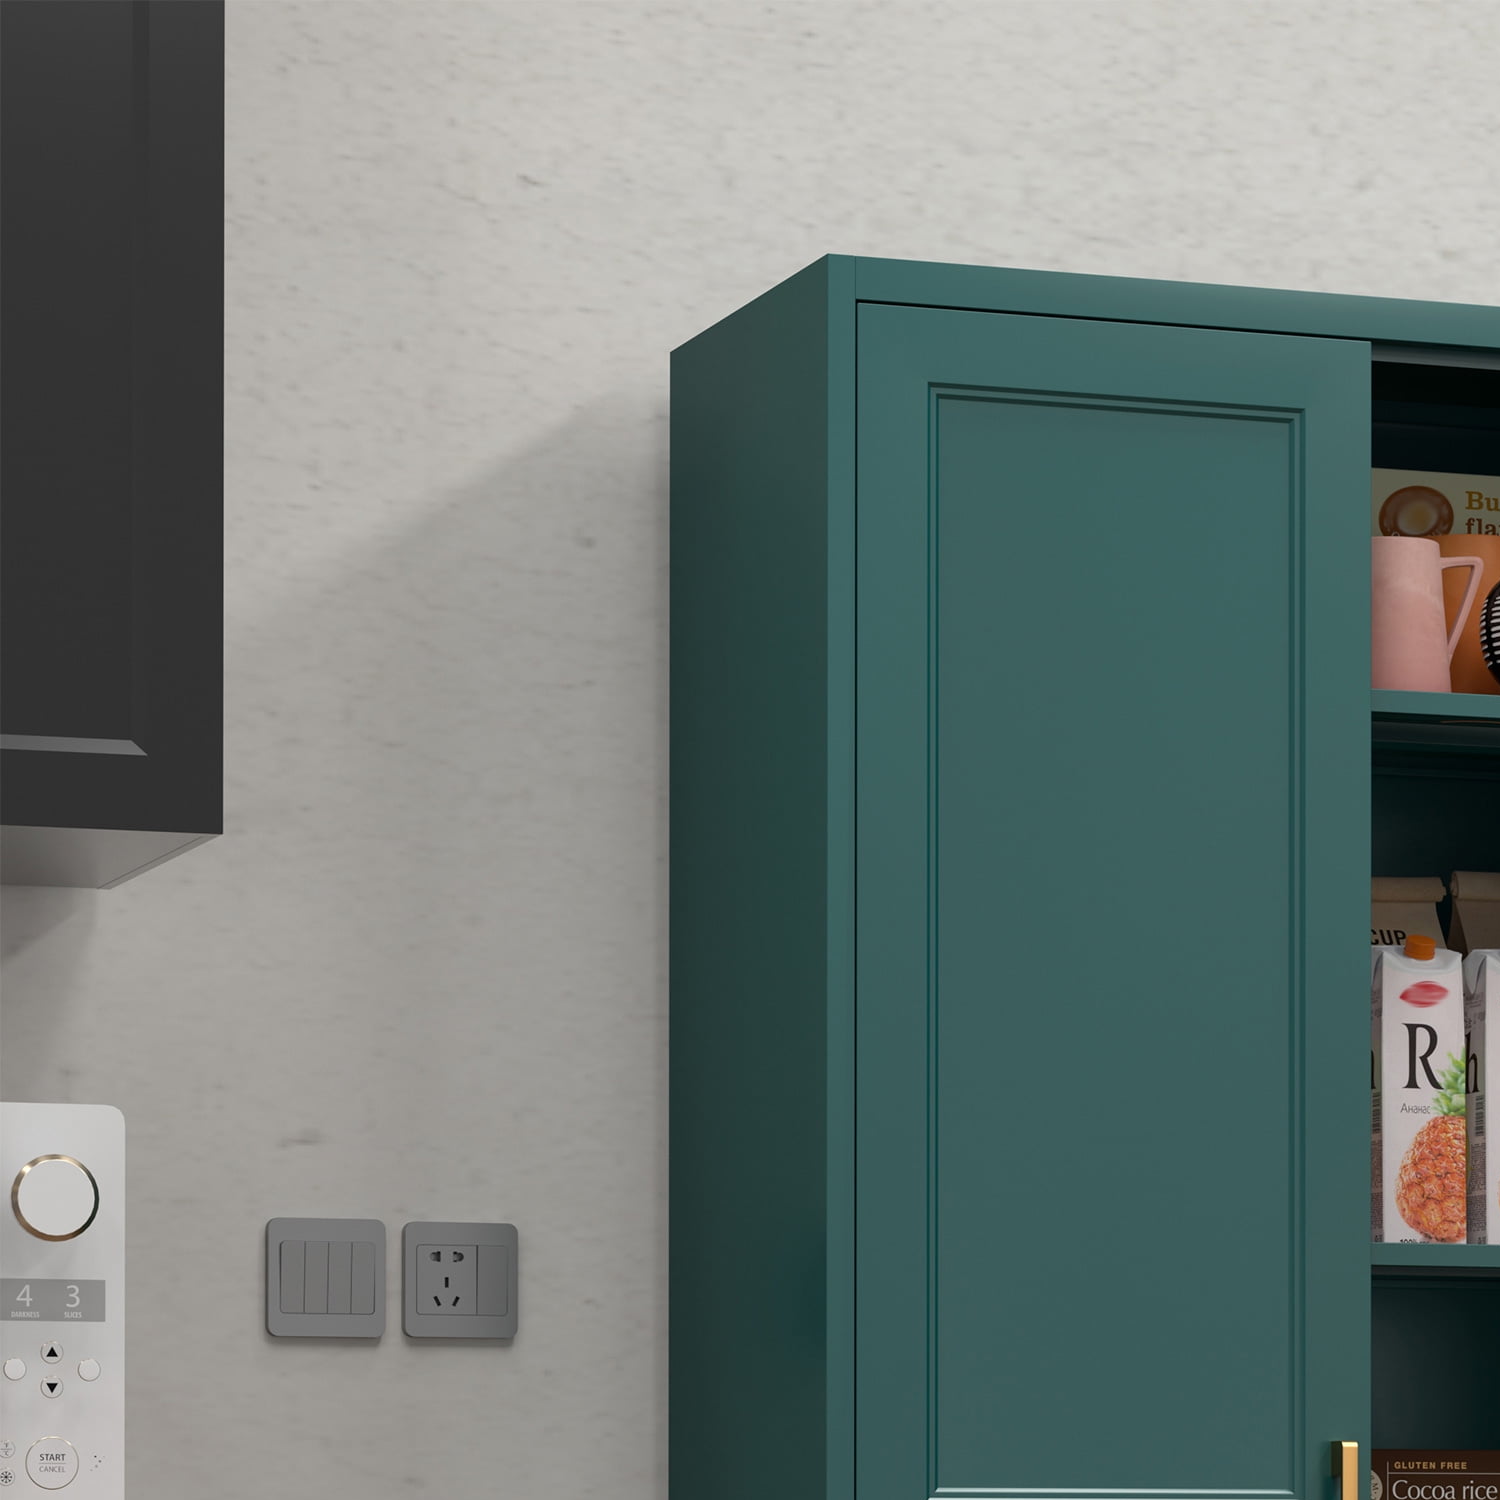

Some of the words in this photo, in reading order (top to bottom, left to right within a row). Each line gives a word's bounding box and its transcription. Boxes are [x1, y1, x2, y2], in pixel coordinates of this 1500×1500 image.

[1402, 1022, 1444, 1090] R
[16, 1284, 33, 1307] 4
[65, 1285, 81, 1308] 3
[39, 1453, 66, 1462] START
[38, 1465, 66, 1473] CANCEL
[1394, 1461, 1436, 1470] GLUTEN
[1440, 1461, 1468, 1470] FREE
[1392, 1479, 1456, 1500] Cocoa
[1462, 1480, 1498, 1500] rice
